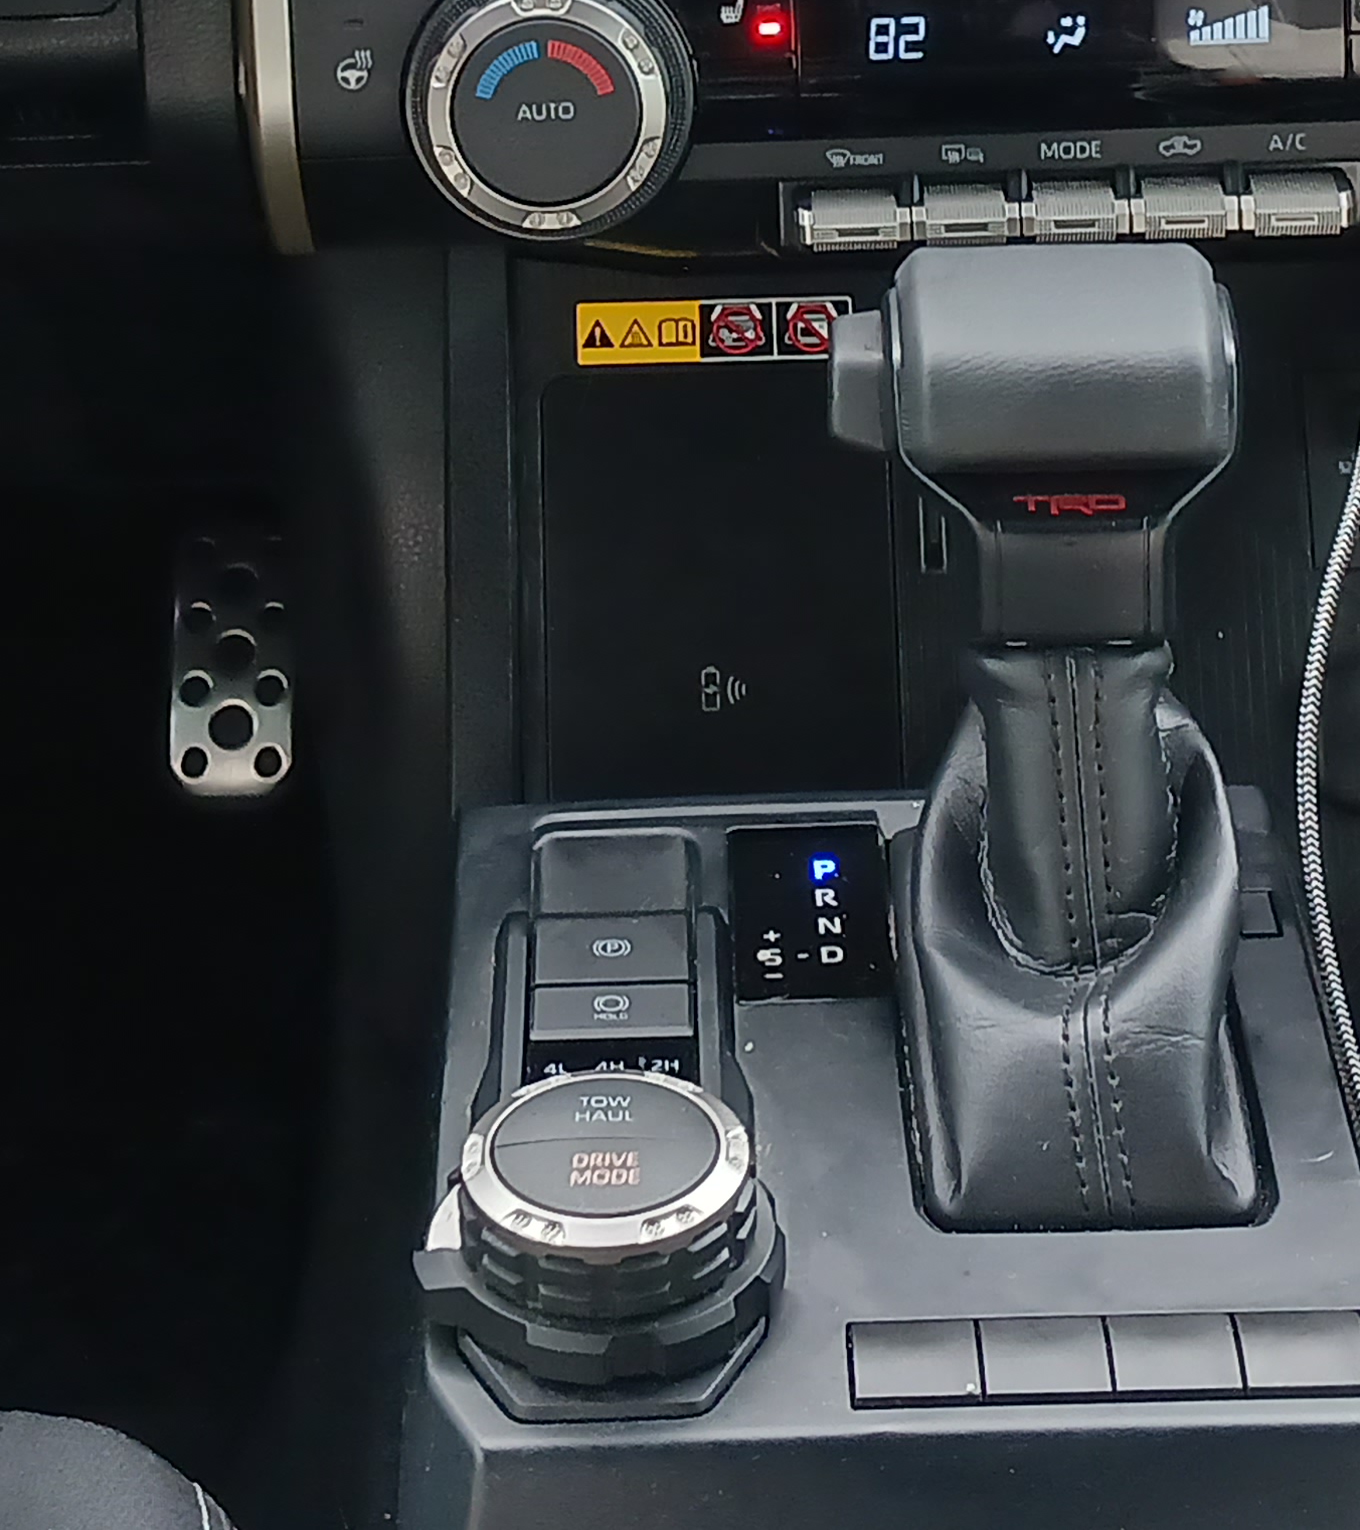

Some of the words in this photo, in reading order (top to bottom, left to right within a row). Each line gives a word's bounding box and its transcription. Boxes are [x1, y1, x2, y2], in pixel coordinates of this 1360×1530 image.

[868, 15, 926, 61] 82
[517, 101, 574, 121] AUTO
[1040, 140, 1102, 160] MODE
[1268, 132, 1306, 152] A/C
[1012, 493, 1127, 516] TRD
[812, 860, 837, 881] P
[814, 888, 839, 907] R
[817, 916, 842, 935] N
[819, 945, 844, 964] D
[579, 1095, 631, 1108] TOW
[574, 1105, 633, 1123] HAUL
[572, 1151, 639, 1169] DRIVE
[570, 1169, 640, 1187] MODE
